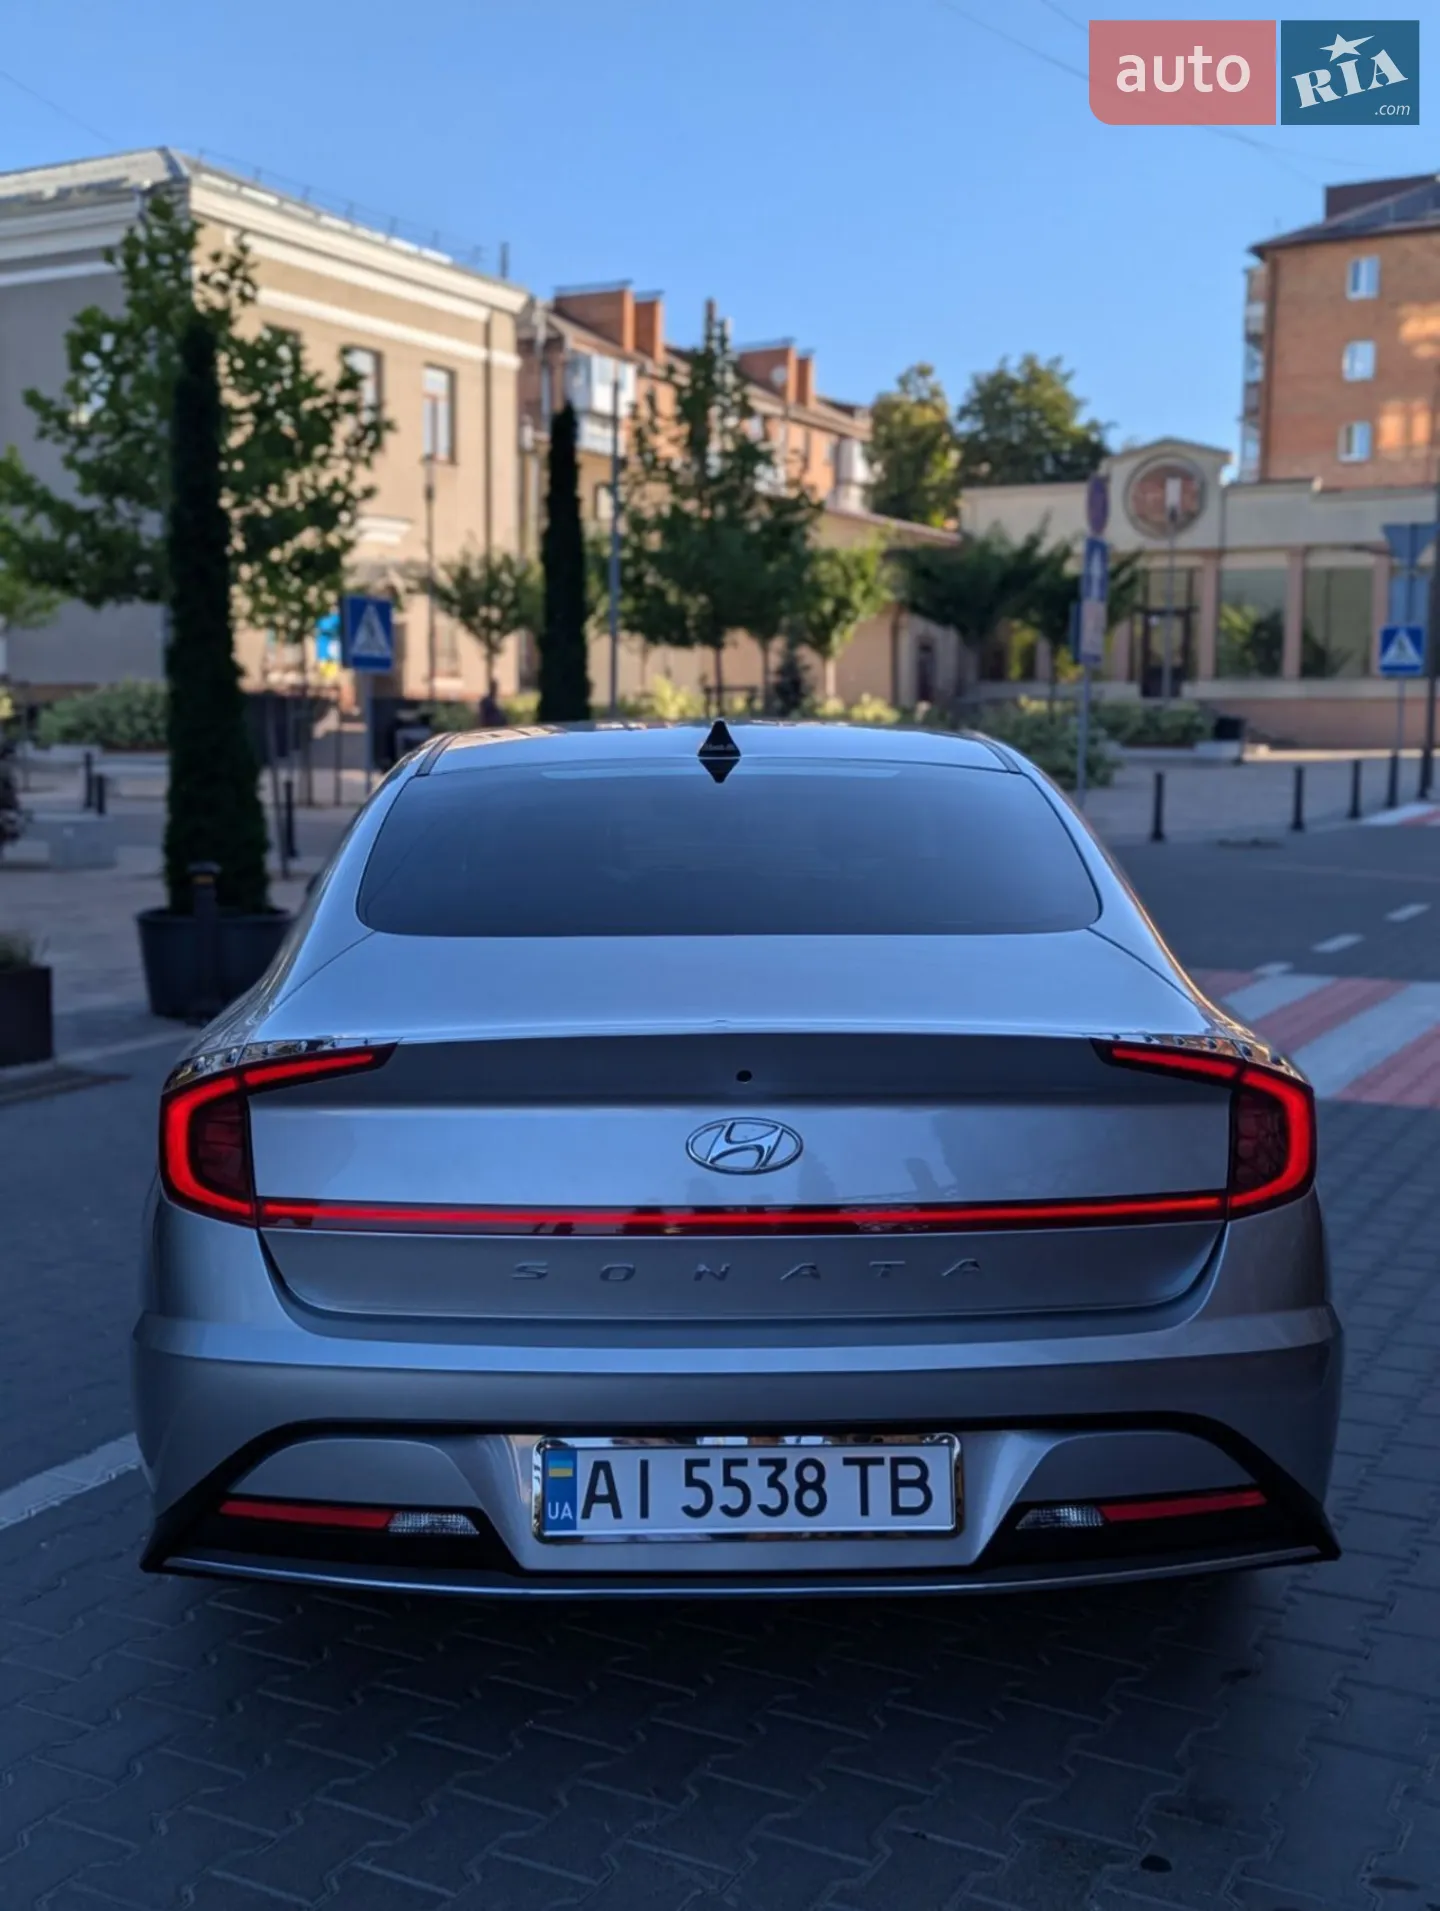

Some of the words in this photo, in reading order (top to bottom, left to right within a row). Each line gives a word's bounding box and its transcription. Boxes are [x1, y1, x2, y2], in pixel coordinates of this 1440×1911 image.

[511, 1257, 982, 1282] SONATA
[580, 1458, 650, 1520] AI
[680, 1456, 828, 1519] 5538
[842, 1455, 934, 1517] TB
[547, 1501, 574, 1521] UA
